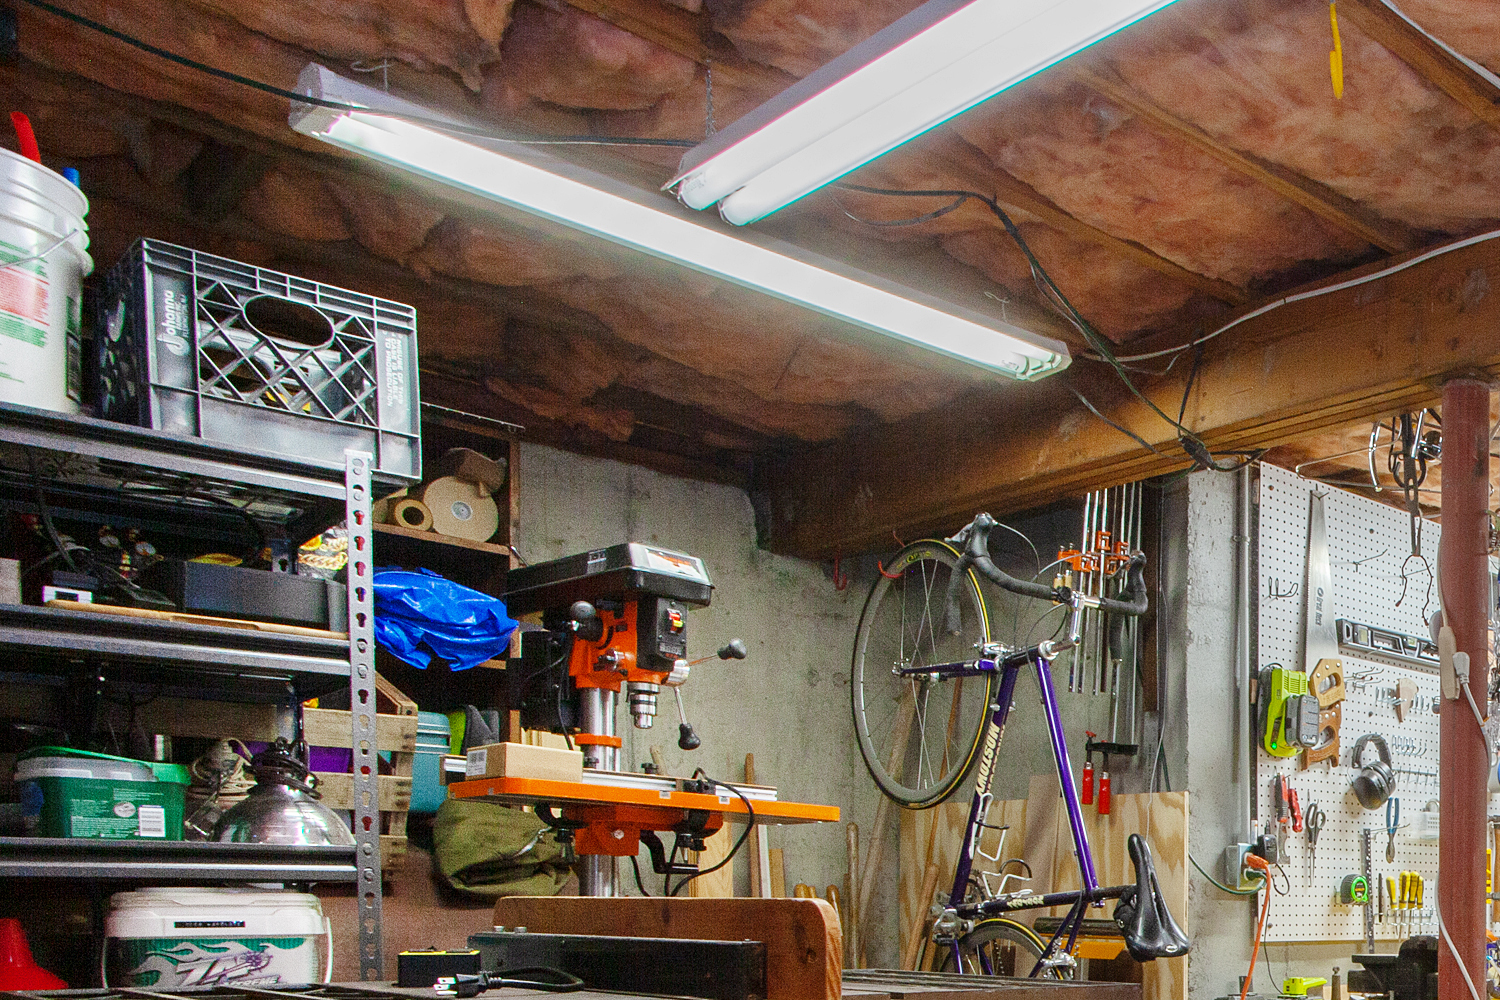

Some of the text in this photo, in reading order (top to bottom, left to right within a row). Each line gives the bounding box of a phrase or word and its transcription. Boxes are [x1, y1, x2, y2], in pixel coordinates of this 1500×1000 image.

[156, 289, 191, 356] Johanna
[384, 337, 394, 408] TO PROSECUTION
[391, 361, 398, 371] IS
[391, 372, 399, 400] LIABLE
[396, 338, 405, 405] MISUSE OF THIS
